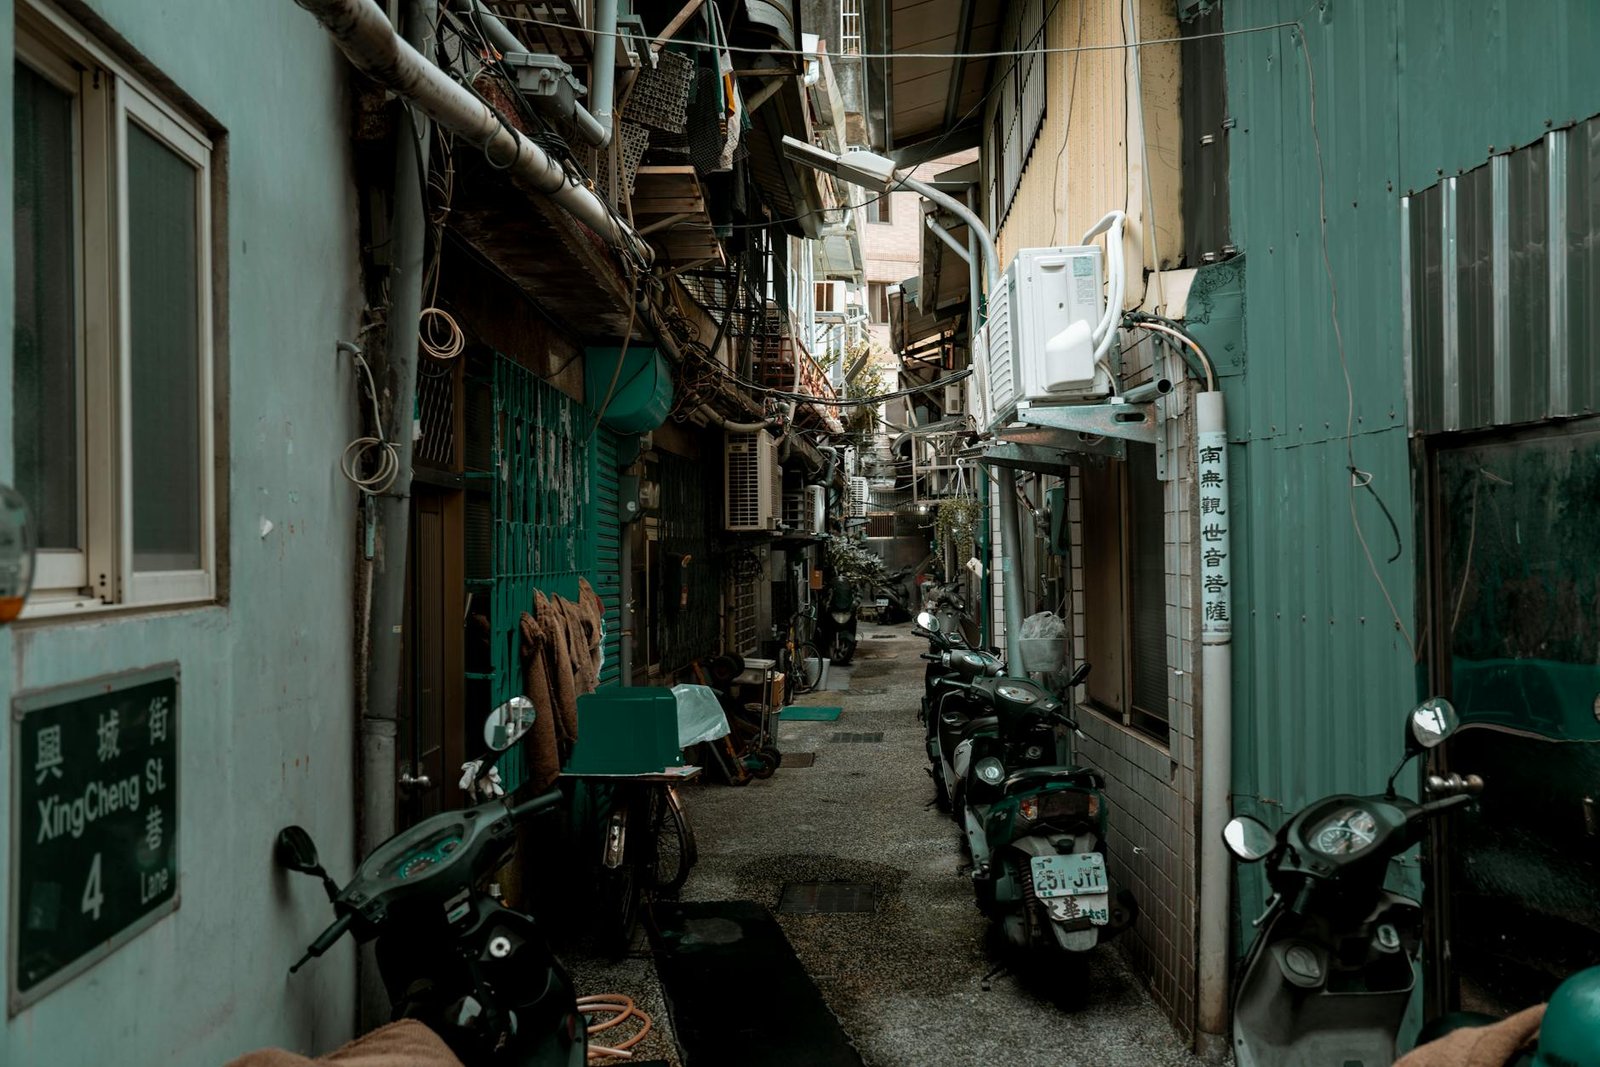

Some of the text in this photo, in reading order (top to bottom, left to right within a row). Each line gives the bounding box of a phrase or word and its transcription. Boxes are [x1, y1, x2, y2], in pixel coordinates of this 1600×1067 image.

[1200, 446, 1230, 621] 南無觀世音菩薩
[35, 696, 168, 786] 興城街
[37, 758, 166, 844] XingCheng St
[81, 805, 163, 921] 4 巷
[141, 867, 169, 904] Lane
